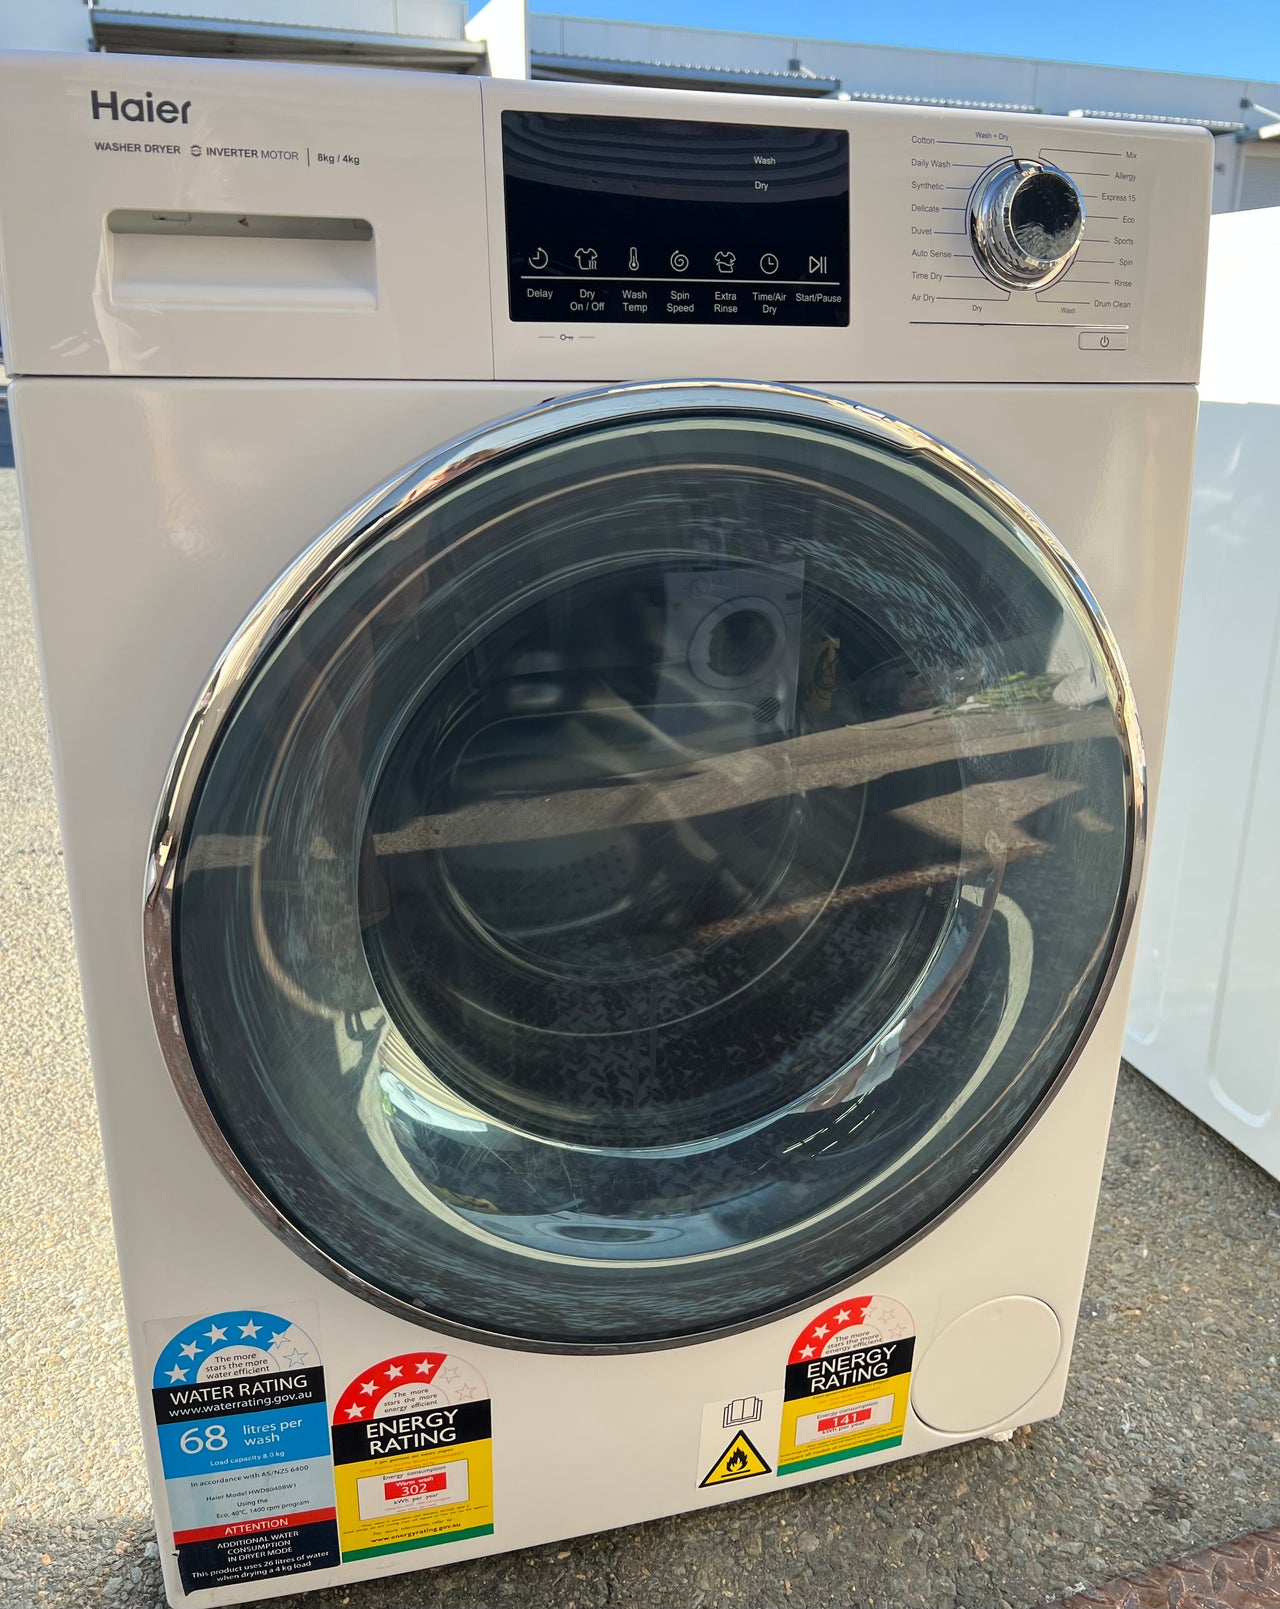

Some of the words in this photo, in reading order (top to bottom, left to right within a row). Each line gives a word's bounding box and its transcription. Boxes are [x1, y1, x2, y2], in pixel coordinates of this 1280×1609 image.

[91, 90, 192, 124] Haier
[911, 136, 935, 145] Cotton
[975, 131, 992, 139] Wash
[999, 133, 1010, 142] Dry
[95, 141, 141, 153] WASHER
[144, 144, 181, 155] DRYER
[206, 147, 258, 159] INVERTER
[261, 150, 299, 161] MOTOR
[317, 153, 335, 165] 8kg
[342, 154, 360, 166] 4kg
[1126, 151, 1138, 159] Mix
[753, 156, 776, 165] Wash
[911, 159, 929, 168] Daily
[930, 160, 951, 169] Wash
[1115, 172, 1136, 182] Allergy
[754, 181, 768, 192] Dry
[911, 182, 945, 192] Synthetic
[1101, 193, 1128, 203] Express
[911, 204, 940, 213] Delicate
[1122, 216, 1135, 224] Eco
[911, 226, 932, 235] Duvet
[1113, 236, 1134, 246] Sports
[911, 249, 928, 258] Auto
[929, 249, 952, 259] Sense
[1119, 258, 1133, 267] Spin
[911, 271, 929, 280] Time
[930, 272, 943, 282] Dry
[1114, 280, 1132, 288] Rinse
[526, 288, 553, 300] Delay
[579, 289, 596, 300] Dry
[622, 290, 648, 299] Wash
[670, 290, 690, 301] Spin
[714, 291, 737, 301] Extra
[752, 291, 787, 301] Time/Air
[795, 293, 842, 303] Start/Pause
[911, 293, 922, 301] Air
[923, 294, 936, 304] Dry
[570, 301, 584, 311] On
[591, 301, 605, 311] Off
[622, 302, 648, 313] Temp
[666, 302, 695, 314] Speed
[714, 304, 738, 313] Rinse
[972, 304, 983, 312] Dry
[1094, 299, 1112, 308] Drum
[1113, 300, 1131, 308] Clean
[762, 304, 778, 315] Dry
[850, 1331, 870, 1339] more
[860, 1333, 880, 1342] more
[825, 1345, 851, 1354] energy
[852, 1338, 882, 1349] efficient
[215, 1355, 232, 1363] The
[233, 1352, 257, 1361] more
[807, 1344, 897, 1378] ENERGY
[205, 1364, 227, 1373] stars
[228, 1361, 243, 1369] the
[245, 1358, 268, 1367] more
[206, 1371, 232, 1380] water
[233, 1365, 270, 1376] efficient
[811, 1362, 888, 1393] RATING
[170, 1385, 234, 1406] WATER
[238, 1374, 308, 1397] RATING
[168, 1391, 312, 1417] www.waterrating.gov.au
[384, 1405, 408, 1413] energy
[411, 1400, 438, 1409] efficient
[816, 1411, 838, 1420] Energy
[838, 1401, 879, 1413] consumption
[366, 1409, 459, 1439] ENERGY
[833, 1413, 857, 1427] 141
[243, 1422, 277, 1435] litres
[280, 1419, 303, 1432] per
[180, 1425, 228, 1455] 68
[244, 1433, 280, 1447] wash
[370, 1427, 457, 1456] RATING
[209, 1459, 229, 1467] Load
[230, 1454, 262, 1464] capacity
[199, 1476, 242, 1487] accordance
[243, 1472, 260, 1480] with
[261, 1467, 289, 1477] AS/NZS
[290, 1464, 309, 1472] 6400
[382, 1472, 404, 1481] Energy
[406, 1465, 447, 1476] consumption
[418, 1475, 434, 1483] wash
[226, 1490, 248, 1499] Model
[401, 1483, 428, 1497] 302
[425, 1492, 439, 1500] year
[237, 1500, 256, 1508] Using
[266, 1504, 280, 1512] rpm
[281, 1499, 310, 1509] program
[225, 1518, 289, 1536] ATTENTION
[217, 1536, 269, 1550] ADDITIONAL
[270, 1530, 299, 1540] WATER
[227, 1540, 291, 1556] CONSUMPTION
[238, 1551, 266, 1562] DRYER
[267, 1546, 293, 1556] MODE
[191, 1570, 209, 1579] This
[210, 1566, 242, 1577] product
[275, 1557, 296, 1566] litres
[296, 1554, 306, 1562] of
[306, 1550, 329, 1560] water
[216, 1574, 240, 1582] when
[240, 1568, 268, 1578] drying
[293, 1560, 312, 1569] load
